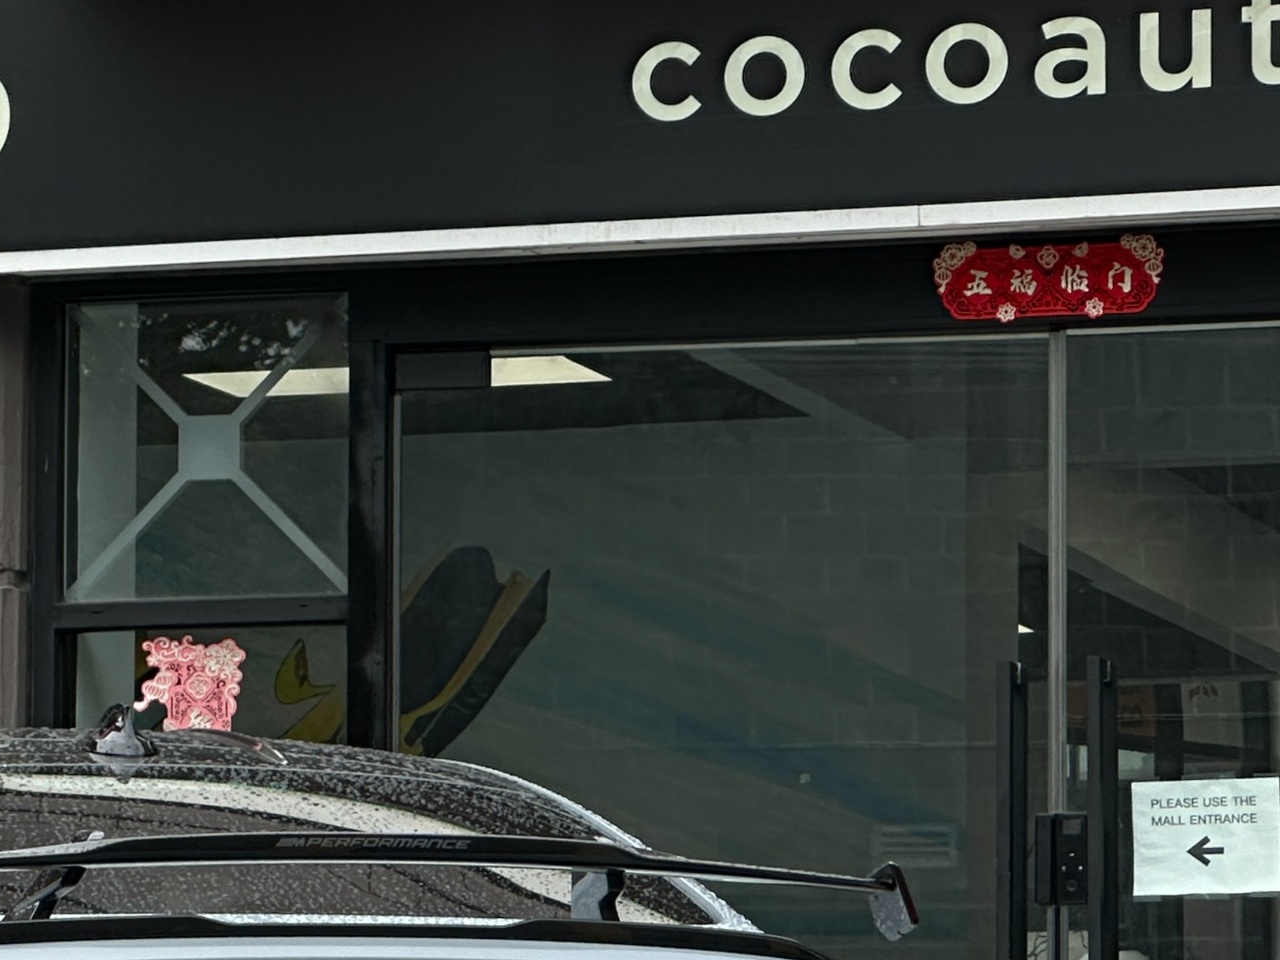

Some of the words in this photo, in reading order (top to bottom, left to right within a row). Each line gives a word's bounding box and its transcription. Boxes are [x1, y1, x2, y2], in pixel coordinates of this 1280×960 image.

[963, 262, 1134, 297] 五福临门
[1150, 797, 1199, 809] PLEASE
[1202, 796, 1229, 808] USE
[1232, 795, 1258, 807] THE
[1151, 815, 1186, 827] MALL
[1189, 813, 1259, 826] ENTRANCE
[306, 837, 472, 849] PERFORMANCE
